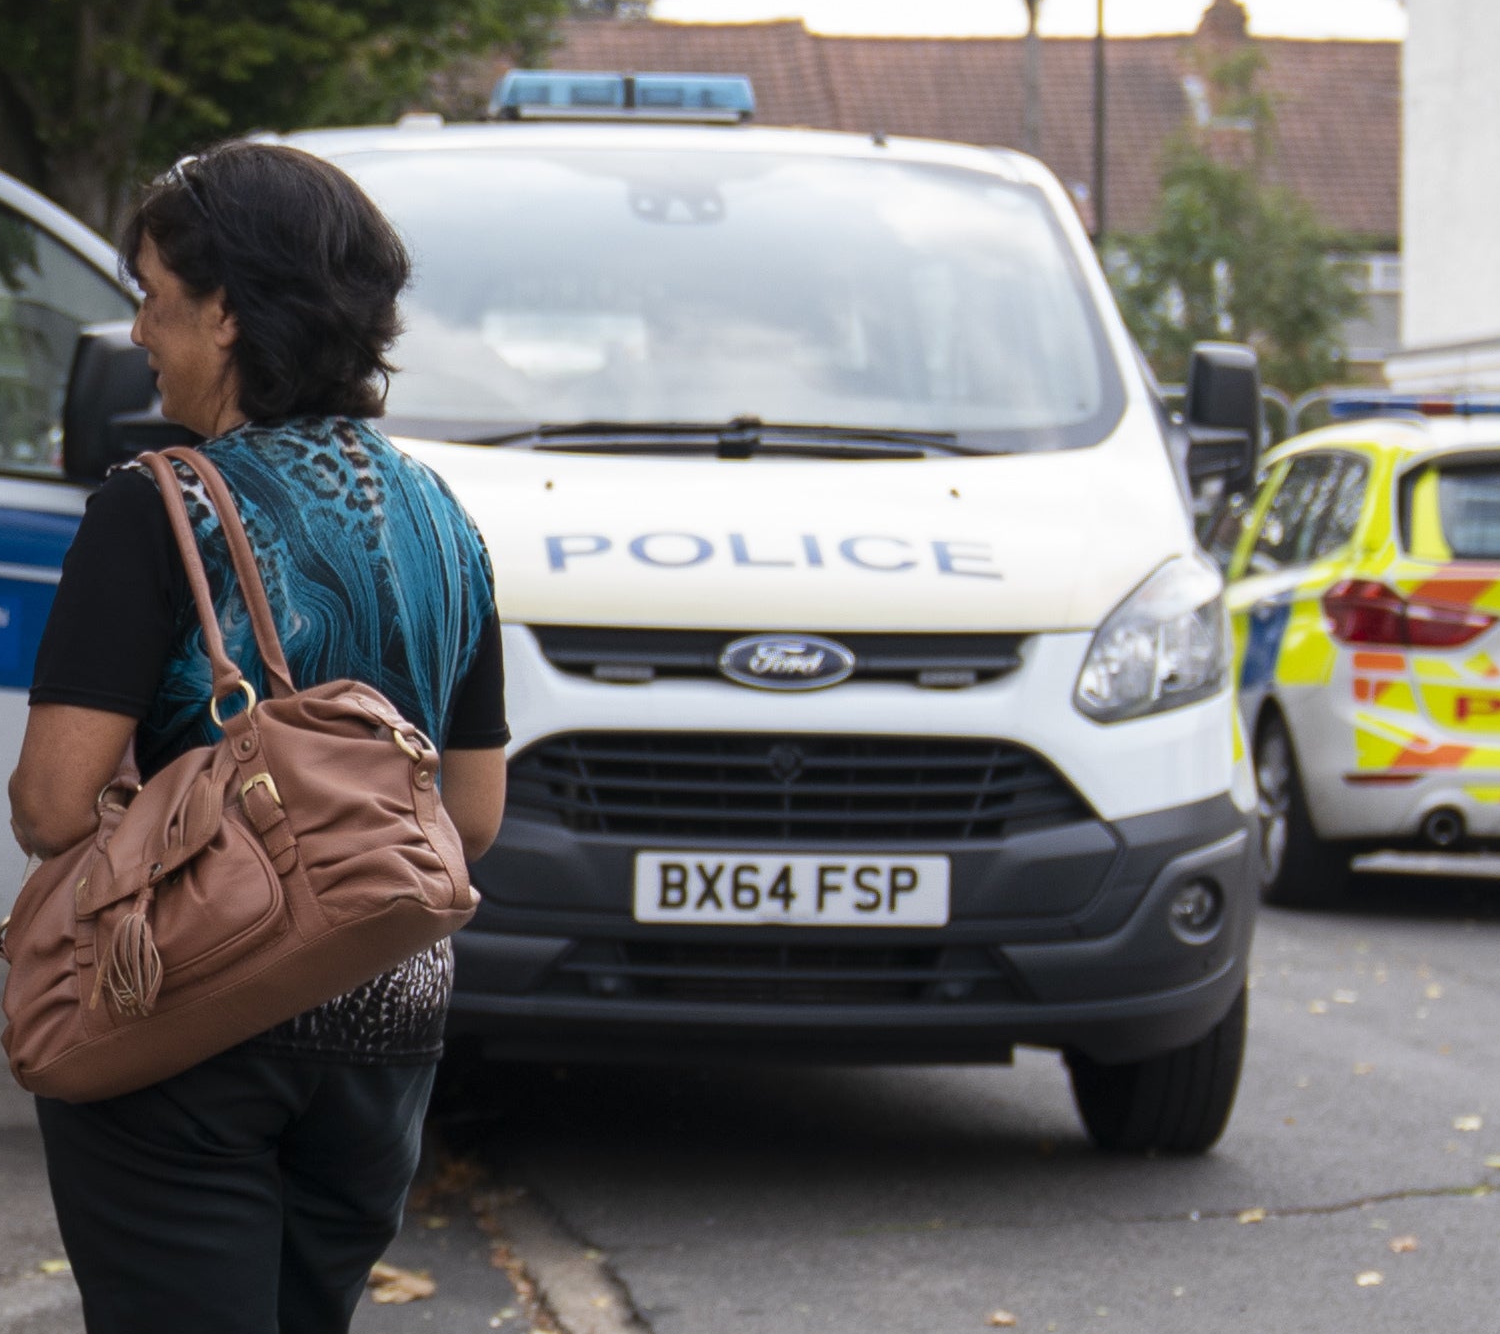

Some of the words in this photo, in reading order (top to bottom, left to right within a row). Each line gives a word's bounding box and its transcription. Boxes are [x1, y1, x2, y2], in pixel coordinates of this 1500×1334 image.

[545, 530, 1004, 581] POLICE
[750, 641, 825, 675] Ford
[657, 863, 796, 913] BX64
[815, 866, 919, 916] FSP
